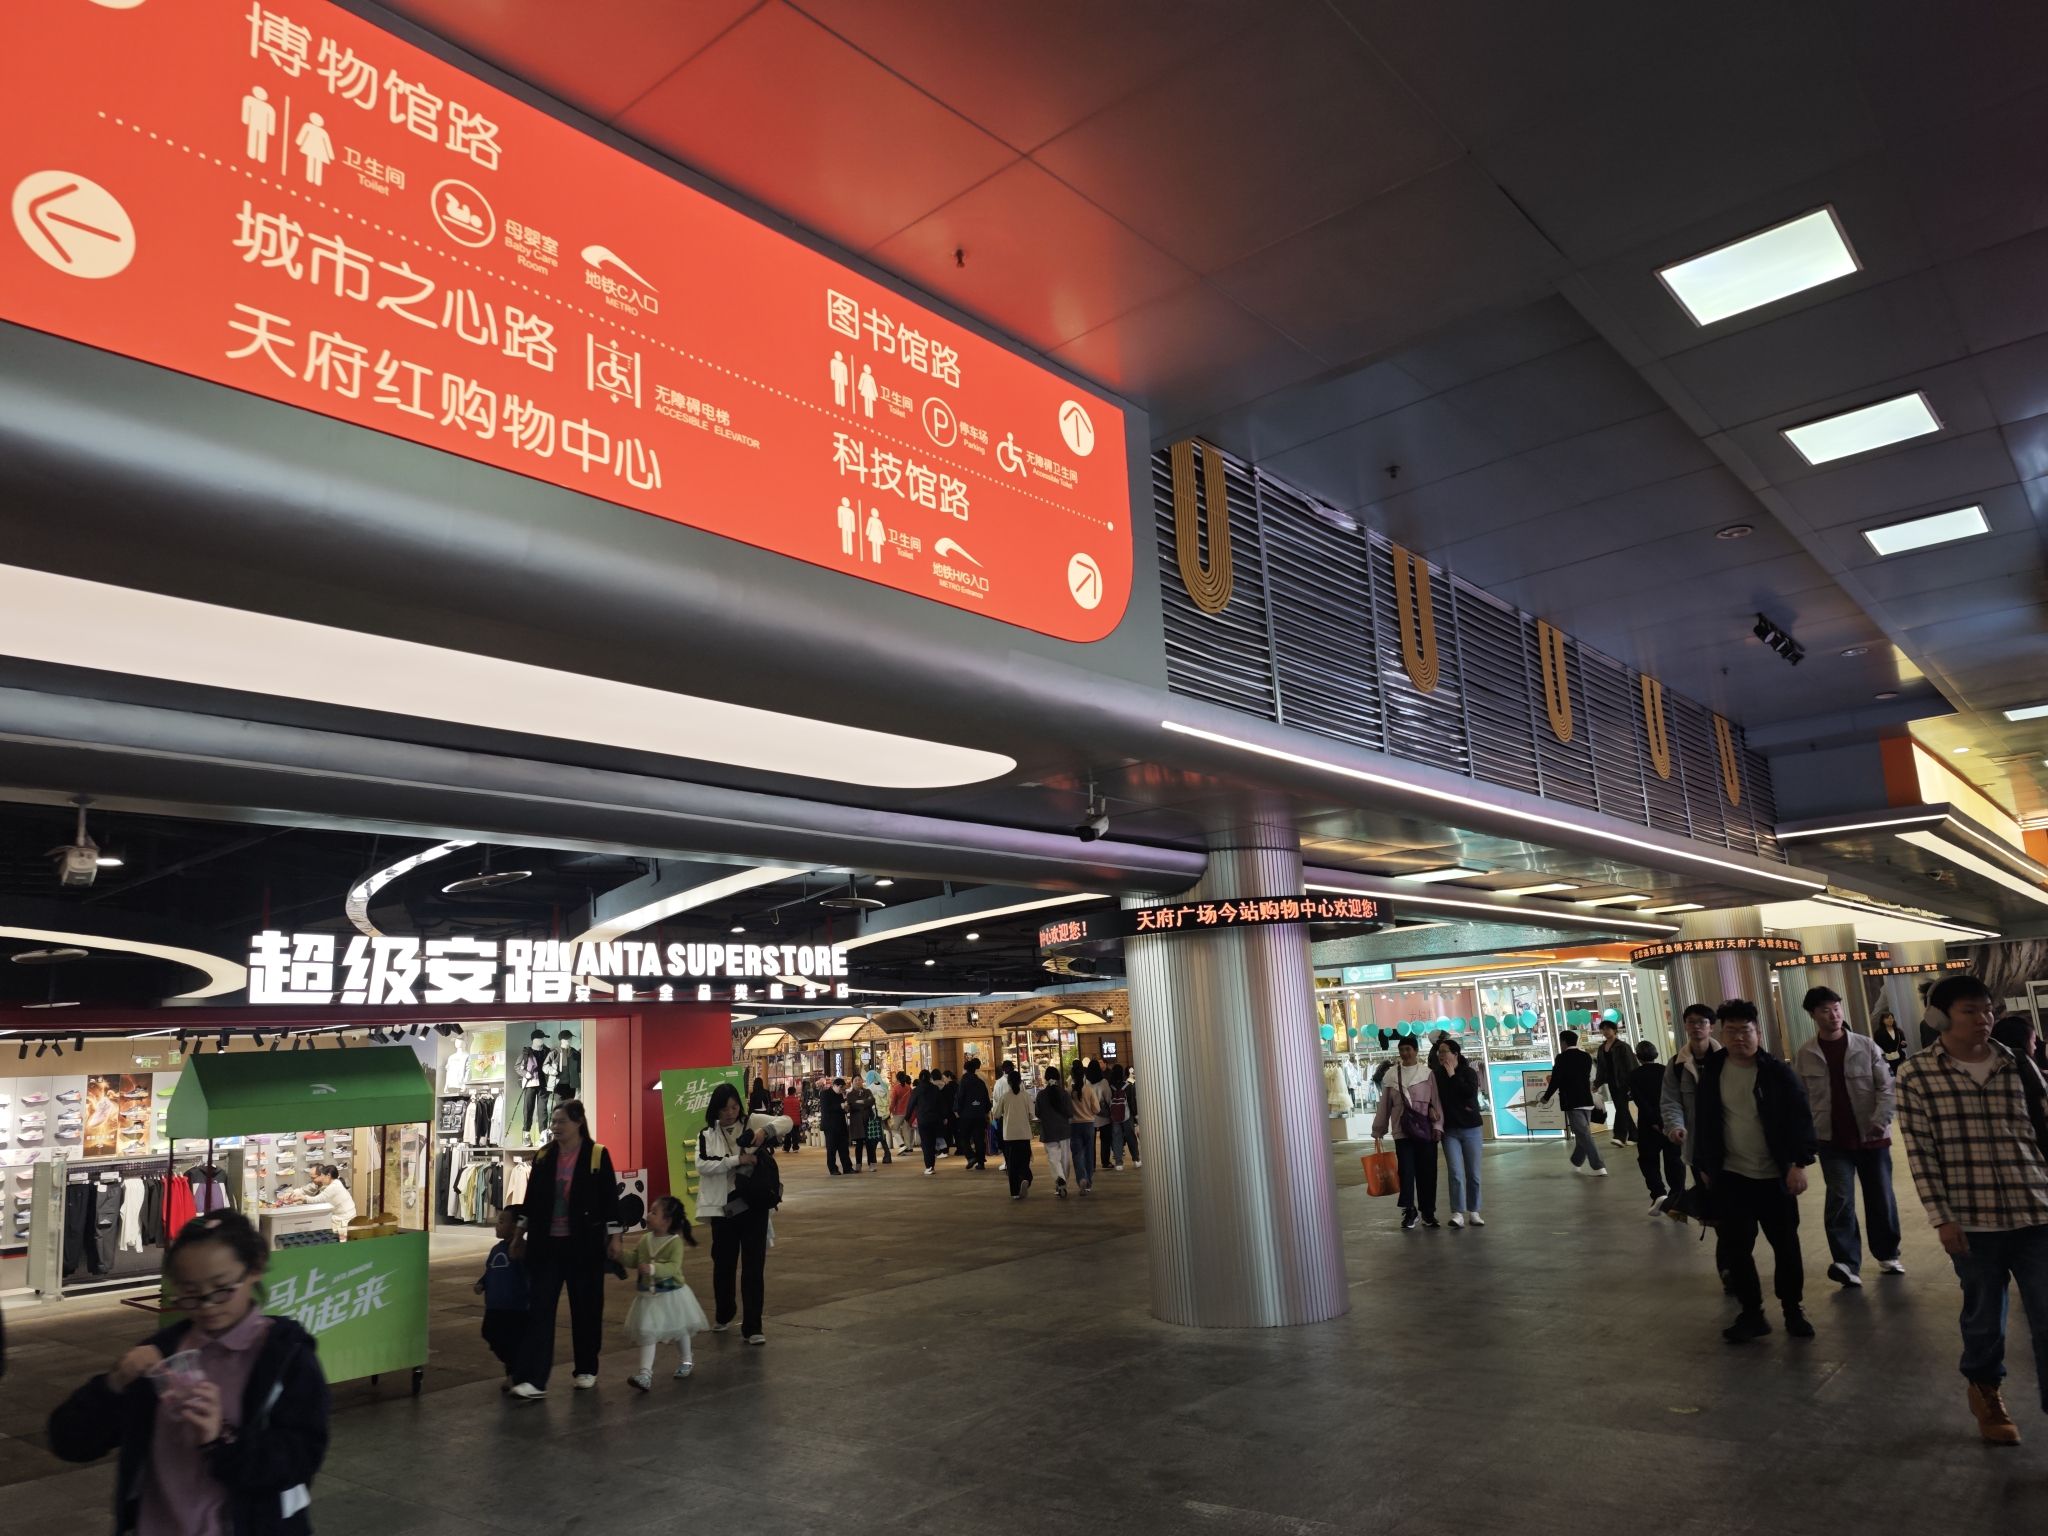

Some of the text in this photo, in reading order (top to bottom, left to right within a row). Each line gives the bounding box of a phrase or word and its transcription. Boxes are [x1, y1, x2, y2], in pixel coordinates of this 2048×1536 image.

[245, 1, 502, 172] 博物馆路
[342, 146, 406, 190] 卫生间
[357, 173, 390, 197] Toilet
[504, 218, 559, 258] 母婴室
[504, 236, 559, 268] Baby Care
[517, 253, 549, 276] Room
[232, 200, 558, 374] 城市之心路
[584, 268, 659, 314] 地铁C入口
[605, 295, 640, 318] METRO
[826, 289, 961, 389] 图书馆路
[225, 303, 662, 490] 天府红购物中心
[654, 384, 731, 427] 无障碍电梯
[879, 385, 914, 413] 卫生间
[655, 403, 761, 450] ACCESIBLE ELEVATOR
[959, 420, 989, 446] 停车场
[963, 438, 986, 456] Parking
[832, 431, 971, 521] 科技馆路
[1026, 450, 1079, 484] 无障碍卫生间
[888, 528, 922, 553] 卫生间
[939, 578, 961, 592] METRO
[248, 930, 572, 1005] 超级安踏
[575, 942, 849, 976] ANTA SUPERSTORE
